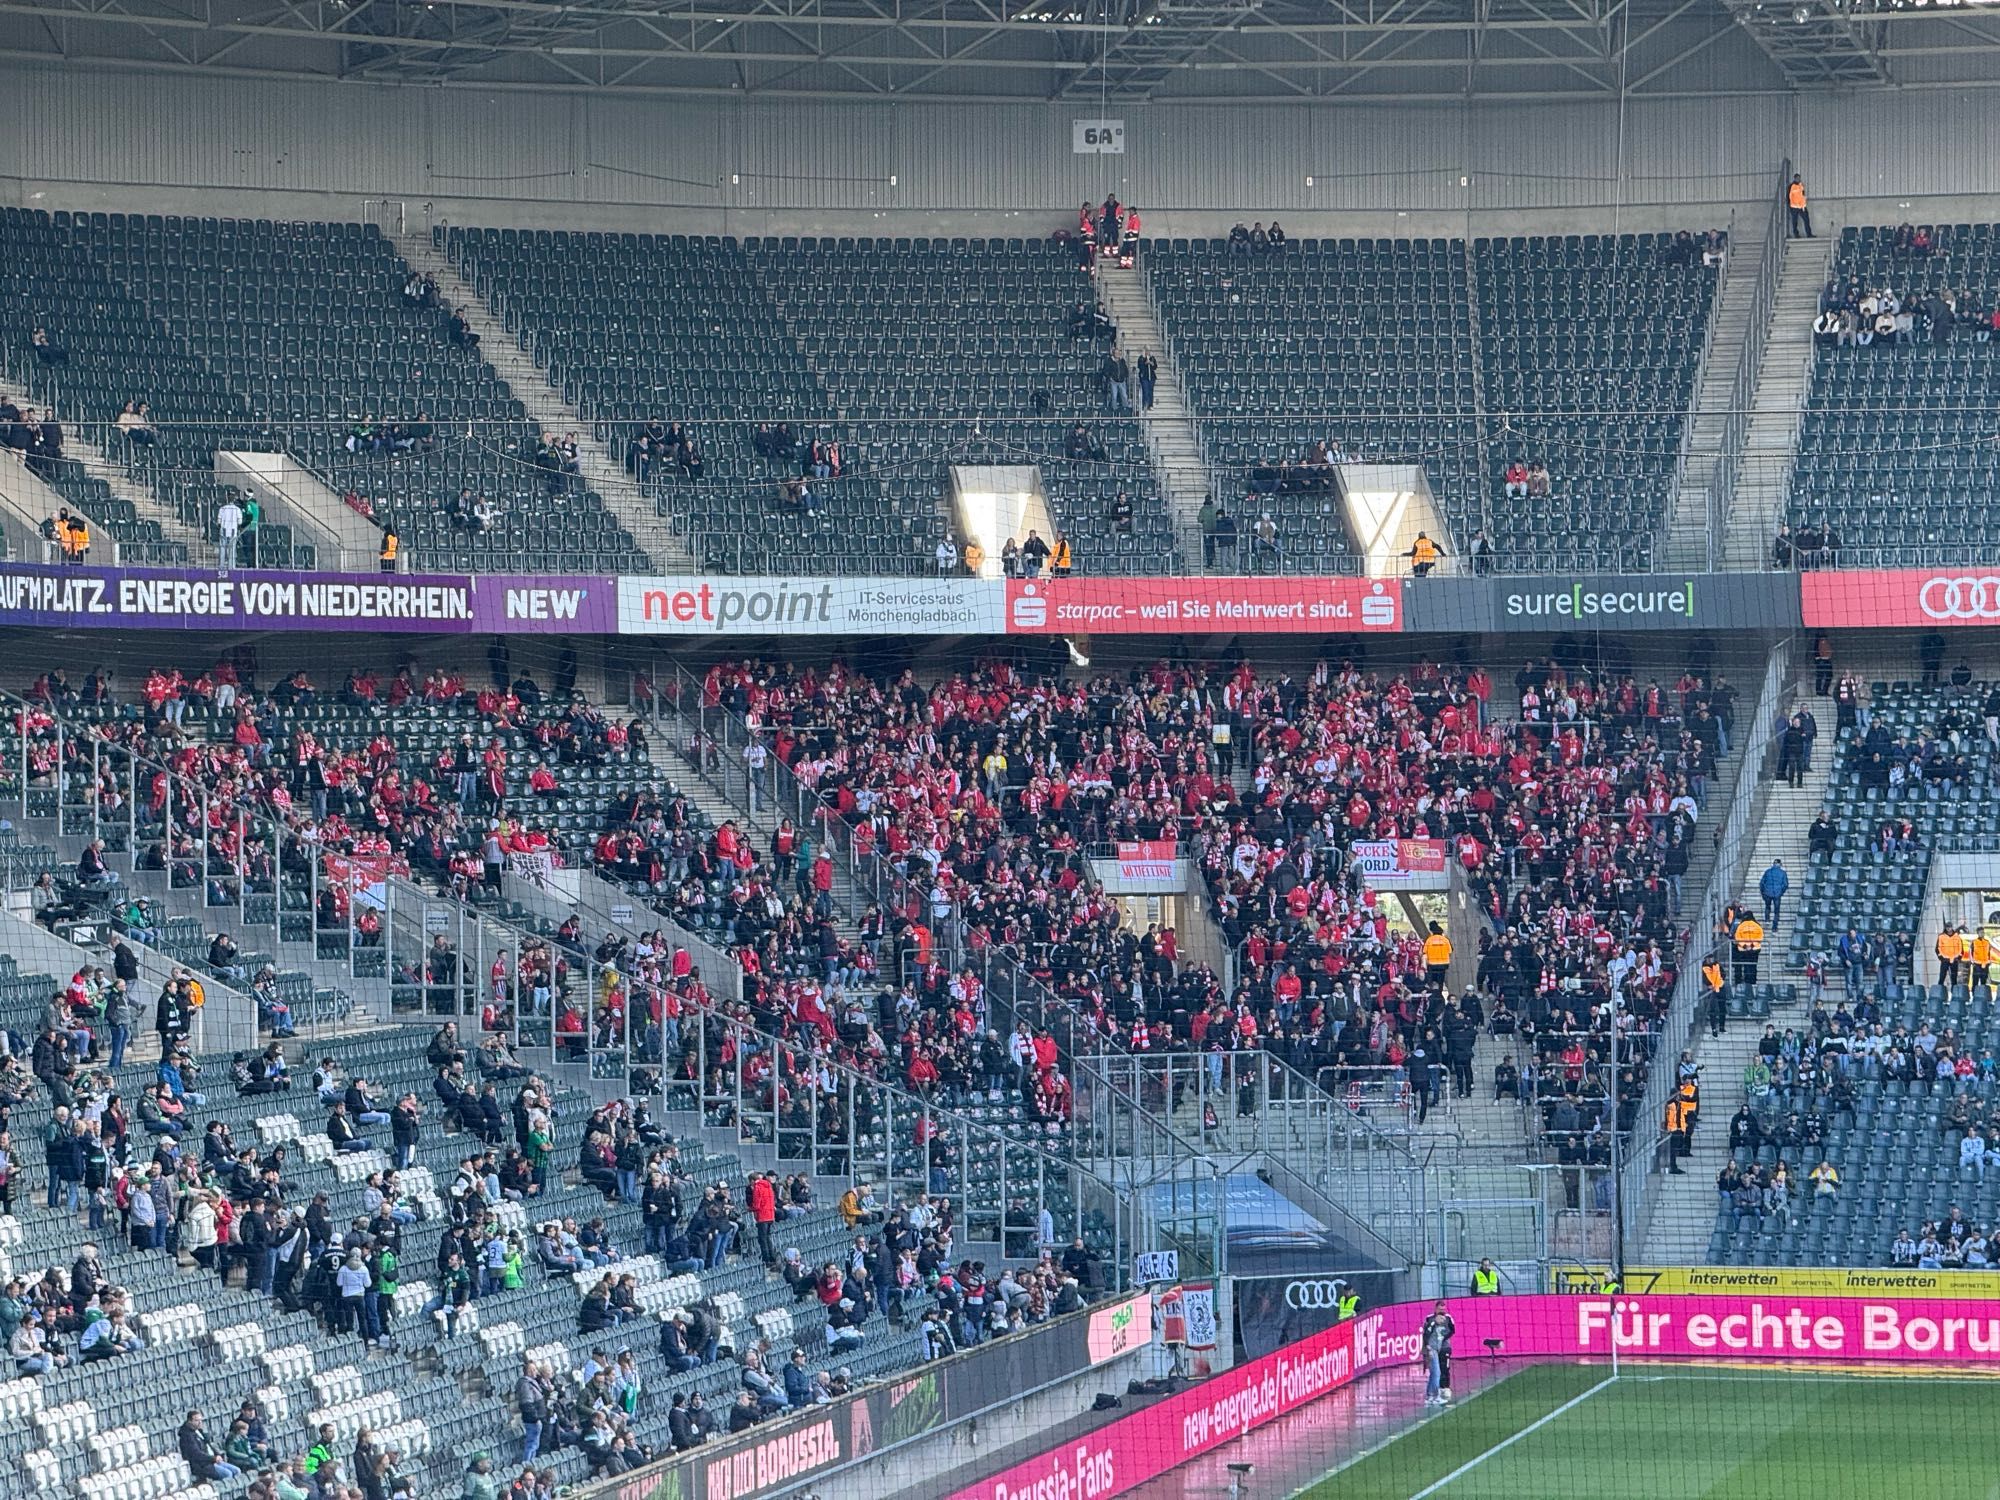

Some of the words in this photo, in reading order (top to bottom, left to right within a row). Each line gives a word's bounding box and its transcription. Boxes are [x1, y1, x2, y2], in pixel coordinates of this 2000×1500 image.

[43, 578, 113, 613] PLATZ.
[120, 580, 235, 615] ENERGIE
[240, 582, 295, 616] VOM
[301, 584, 474, 619] NIEDERRHEIN.
[642, 582, 834, 631] netpoint
[859, 591, 936, 606] IT-Services
[939, 592, 965, 605] aus
[1056, 601, 1122, 622] starpac
[1140, 599, 1178, 618] weil
[1182, 600, 1211, 618] Sie
[1215, 600, 1305, 618] Mehrwert
[1309, 600, 1353, 618] sind.
[848, 608, 977, 625] Mönchengladbach
[1360, 859, 1390, 871] ORD
[1689, 1269, 1778, 1286] interwetten
[1846, 1270, 1937, 1288] interwetten
[1578, 1301, 1671, 1347] Für
[1686, 1303, 1845, 1349] echte
[1183, 1344, 1349, 1451] new-energie.de/Fohlenstrom
[757, 1419, 840, 1490] BORUSSIA.
